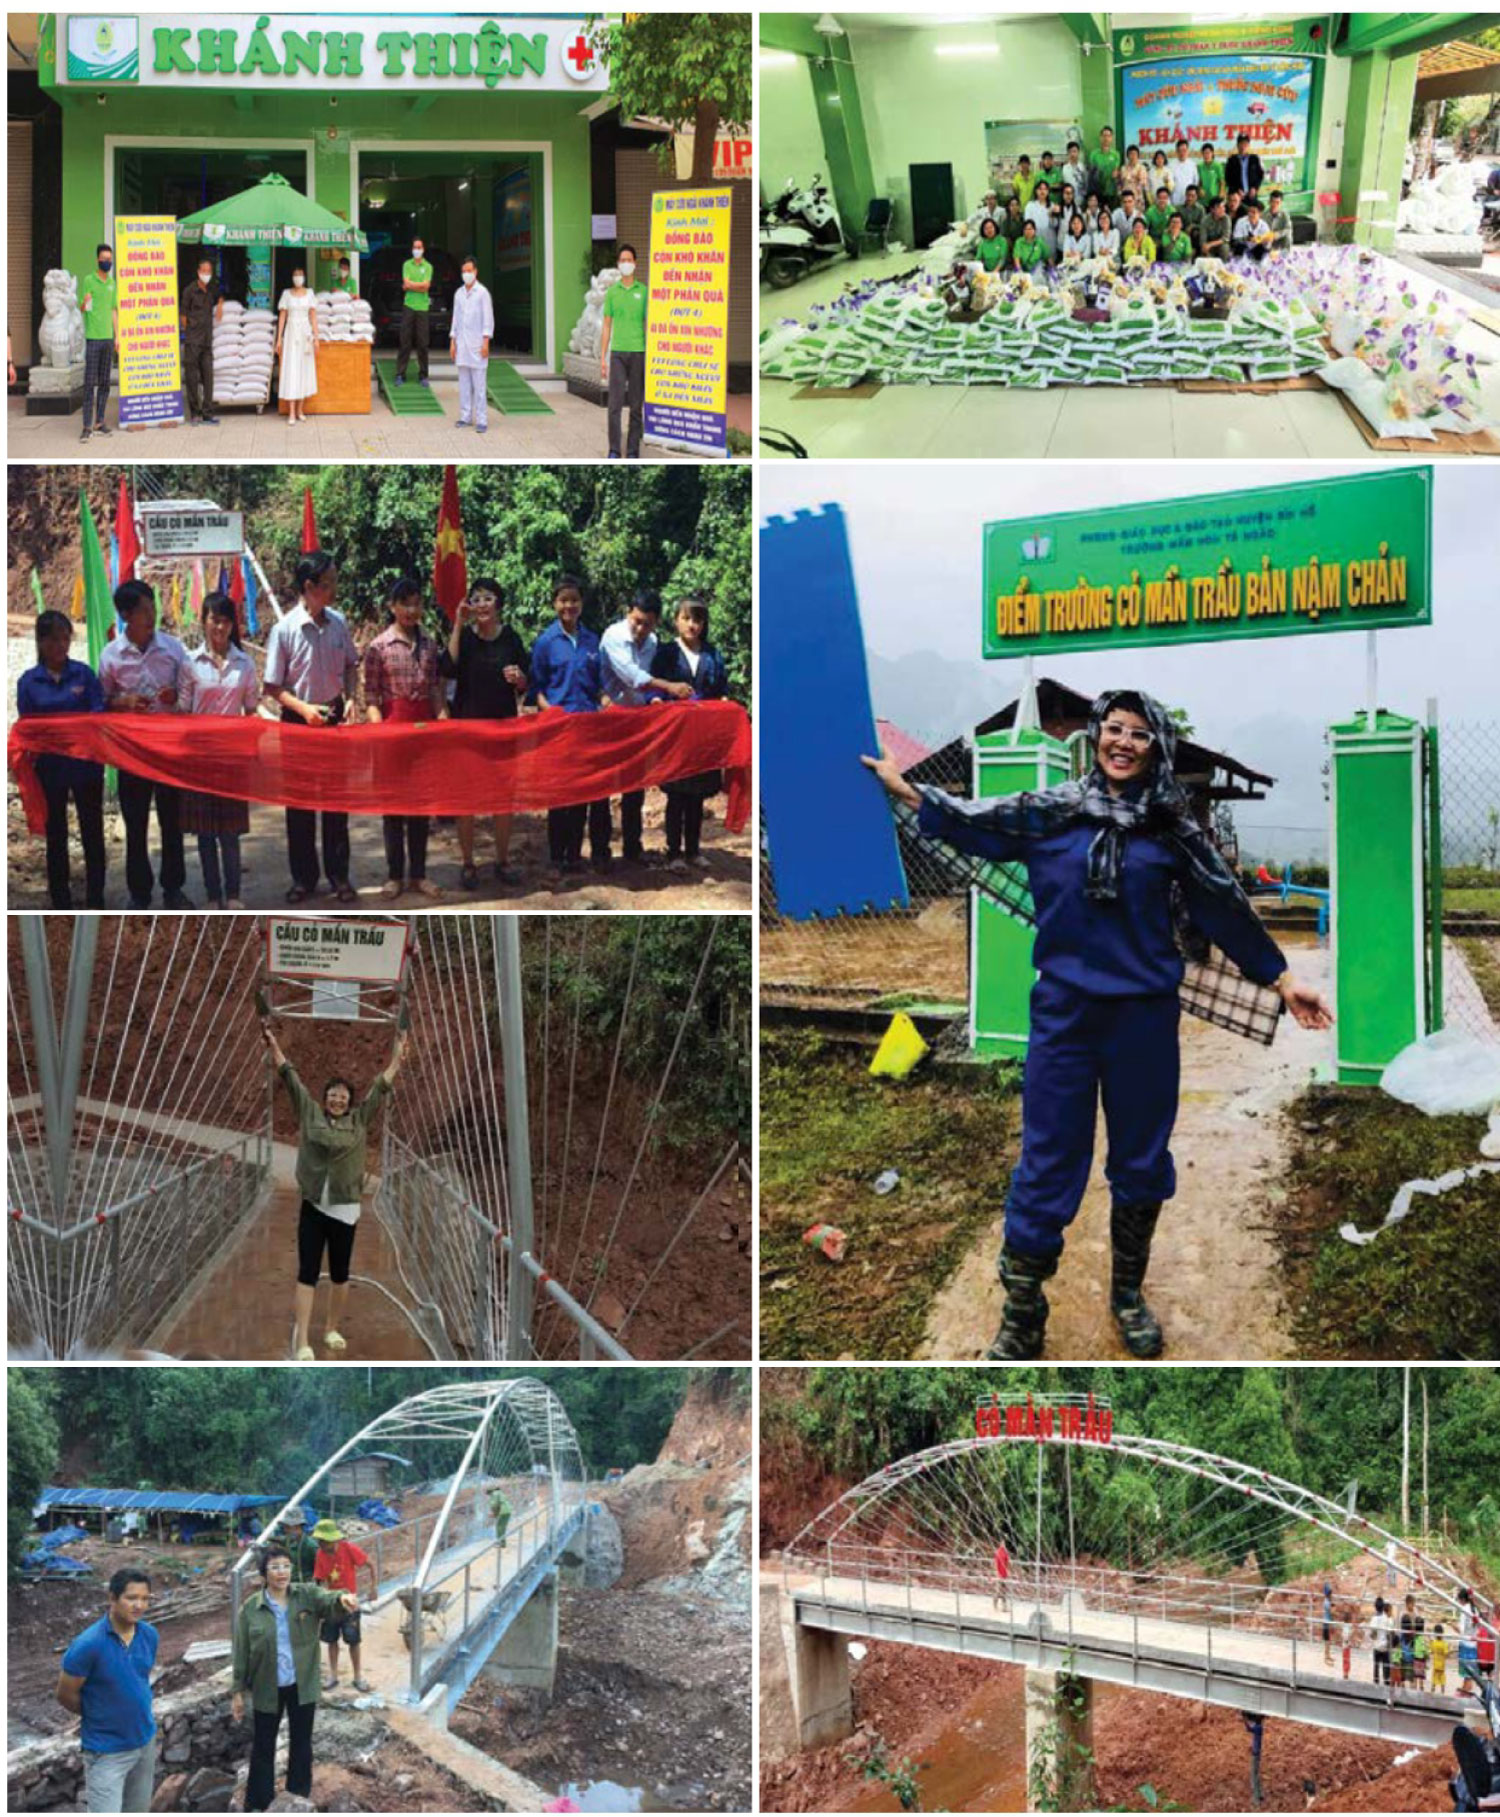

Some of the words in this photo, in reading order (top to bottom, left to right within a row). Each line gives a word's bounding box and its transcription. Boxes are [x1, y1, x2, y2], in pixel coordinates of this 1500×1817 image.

[153, 15, 364, 75] KHÁNH
[376, 20, 548, 88] THIỆN
[1138, 122, 1218, 147] KHÁNH
[1224, 118, 1294, 145] THIỆN
[996, 575, 1042, 637] ĐIỂM
[1044, 571, 1114, 632] TRƯỜNG
[1116, 569, 1142, 627] CỎ
[1145, 564, 1188, 623] MẦN
[1191, 556, 1241, 620] TRẦU
[1246, 554, 1287, 616] BẢN
[1292, 554, 1341, 620] NẬM
[1347, 541, 1407, 607] CHẢN
[975, 1392, 1000, 1438] CỎ
[1005, 1390, 1053, 1439] MẦN
[1058, 1390, 1113, 1444] TRẦU
